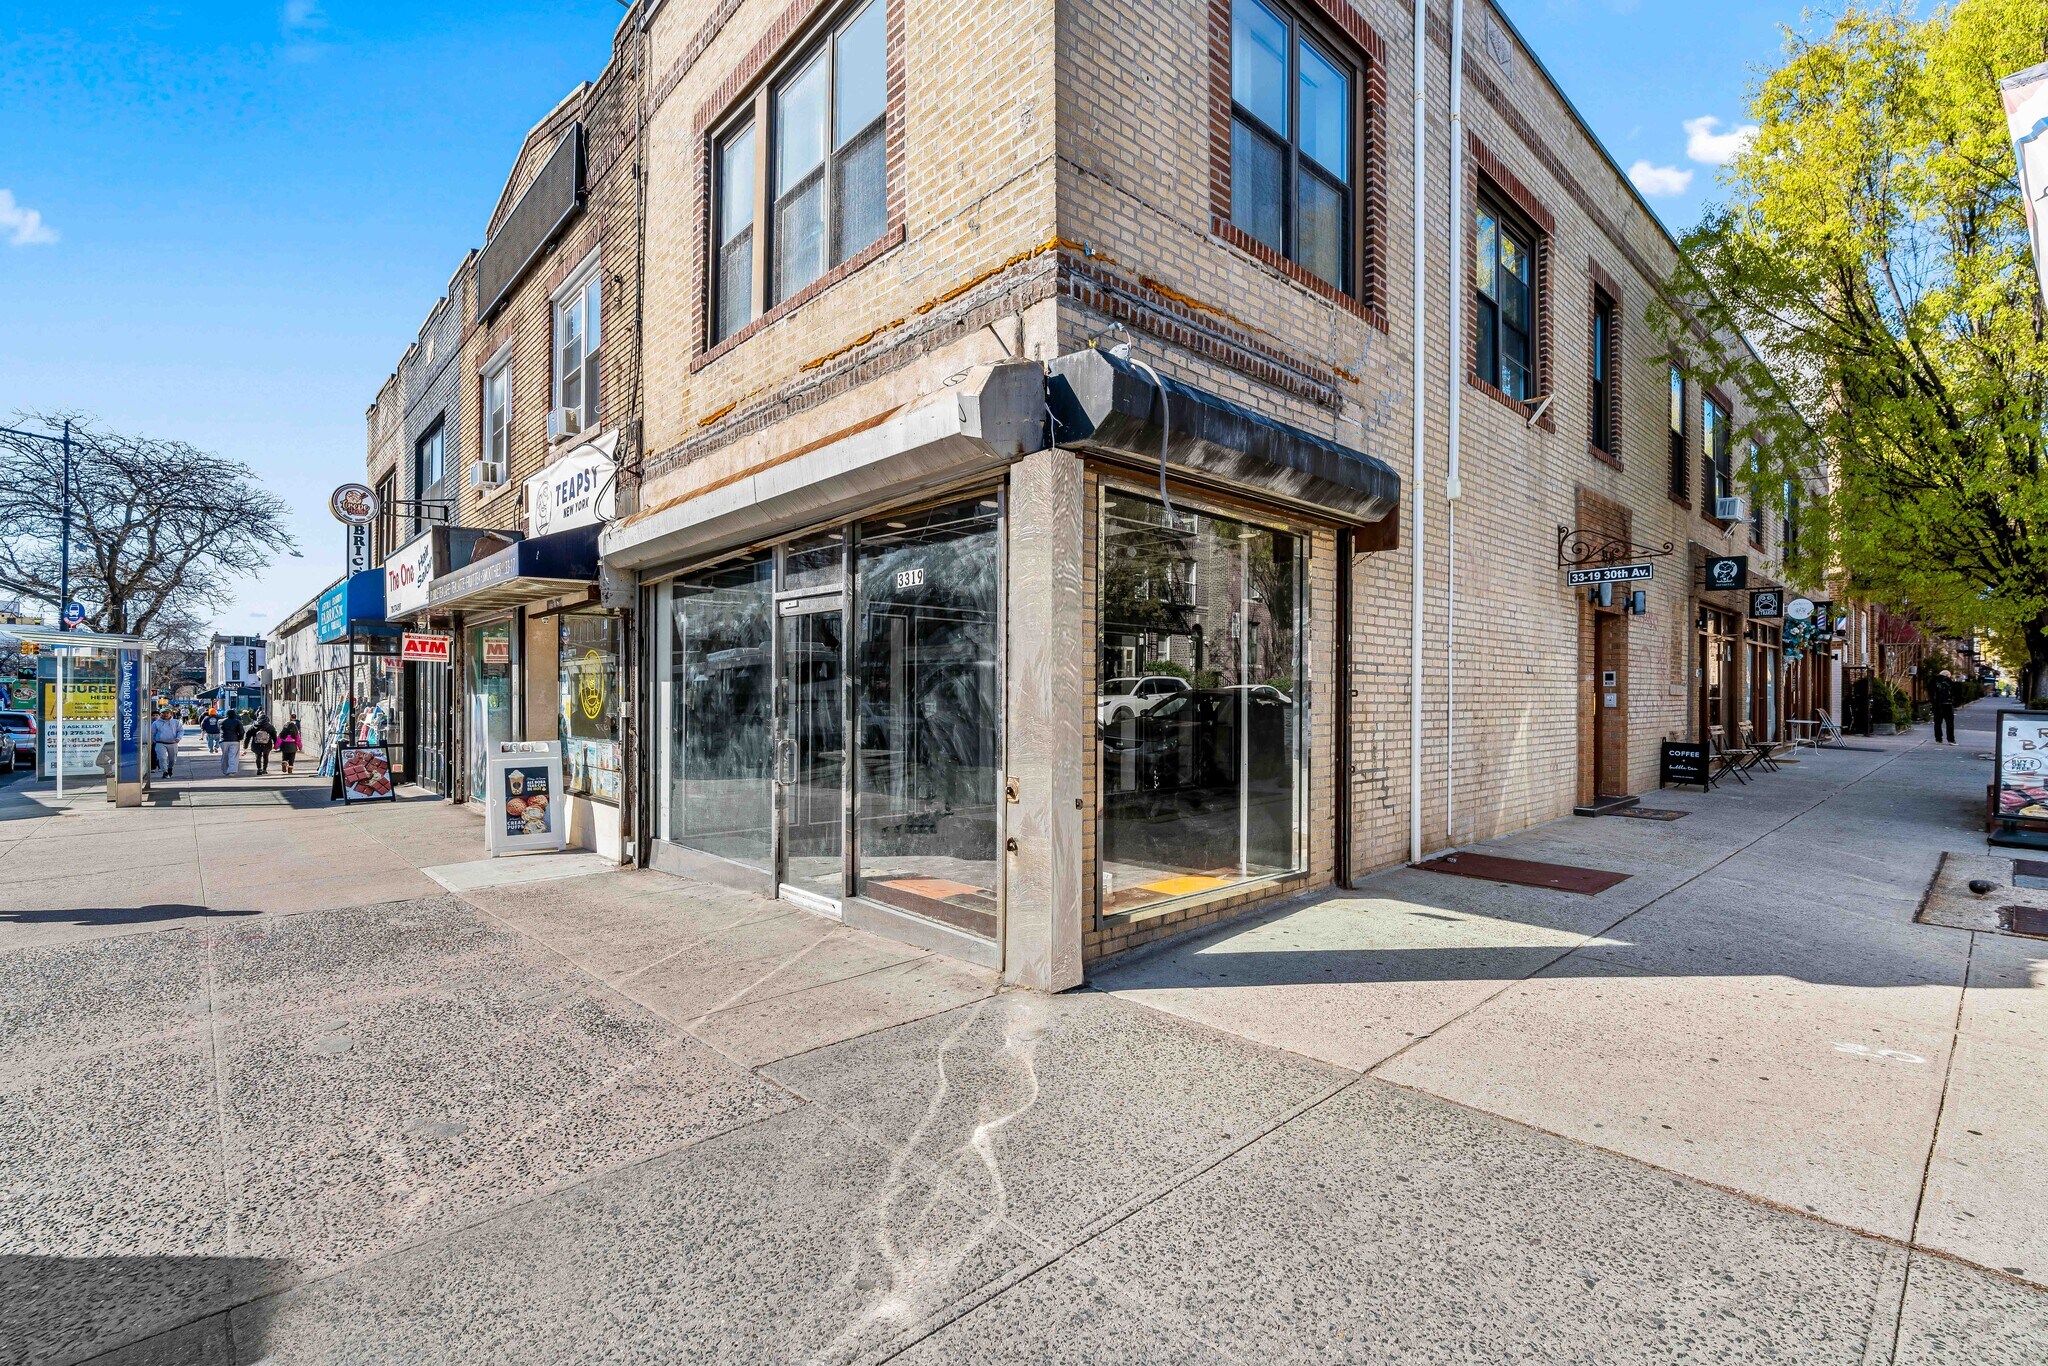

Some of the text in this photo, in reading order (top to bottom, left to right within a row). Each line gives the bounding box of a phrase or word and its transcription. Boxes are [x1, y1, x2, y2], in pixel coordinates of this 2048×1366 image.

[556, 465, 600, 507] TEAPSY
[563, 497, 590, 518] NEW YORK
[388, 563, 415, 592] The One
[417, 556, 433, 589] Salon
[898, 569, 923, 587] 3319
[1571, 567, 1649, 582] 33-19 30th Av.
[405, 640, 447, 654] ATM
[122, 661, 133, 671] 30
[52, 685, 116, 694] INJURED
[123, 671, 133, 699] Avenue
[123, 718, 133, 741] Street
